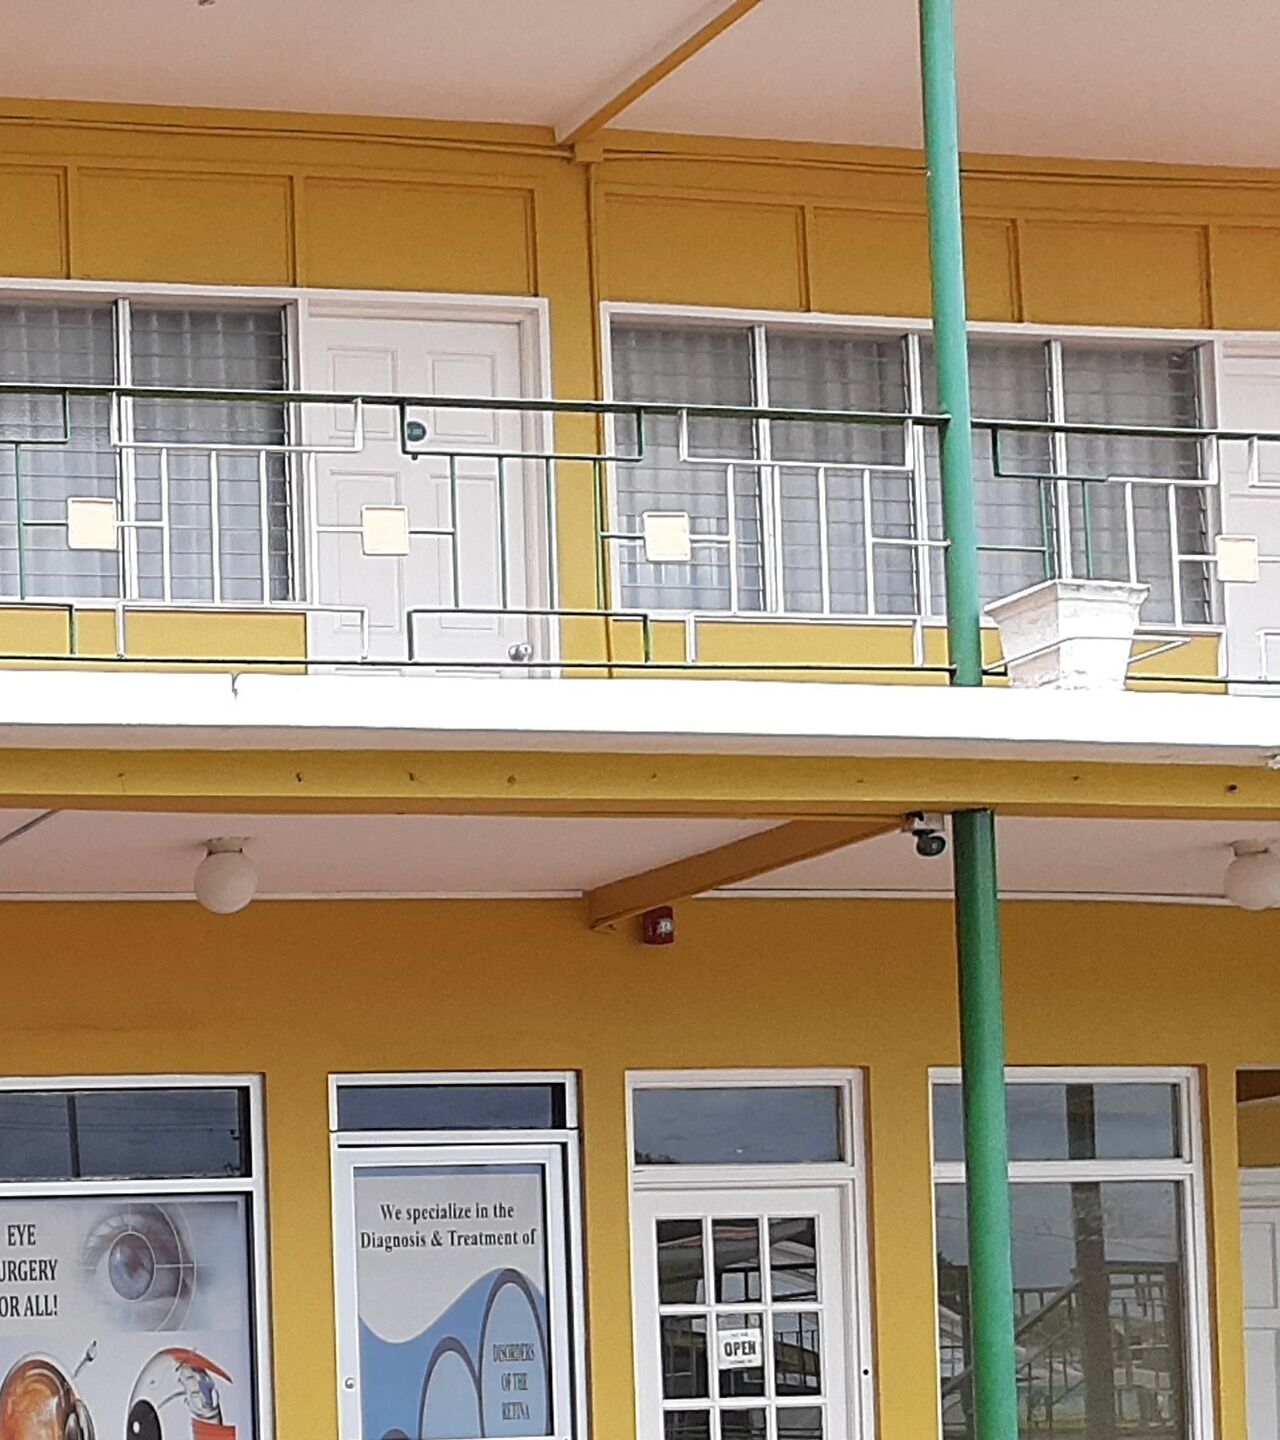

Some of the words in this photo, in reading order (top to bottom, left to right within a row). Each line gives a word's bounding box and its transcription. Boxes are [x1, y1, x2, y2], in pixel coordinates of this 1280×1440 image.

[380, 1204, 402, 1220] We
[406, 1202, 472, 1225] specialize
[476, 1202, 488, 1219] in
[494, 1202, 515, 1219] the
[7, 1224, 36, 1246] EYE
[360, 1231, 427, 1253] Diagnosis
[431, 1230, 443, 1247] &
[447, 1229, 521, 1247] Treatment
[522, 1228, 537, 1245] of
[24, 1295, 58, 1317] ALL!
[724, 1341, 756, 1357] OPEN
[513, 1372, 528, 1391] THE
